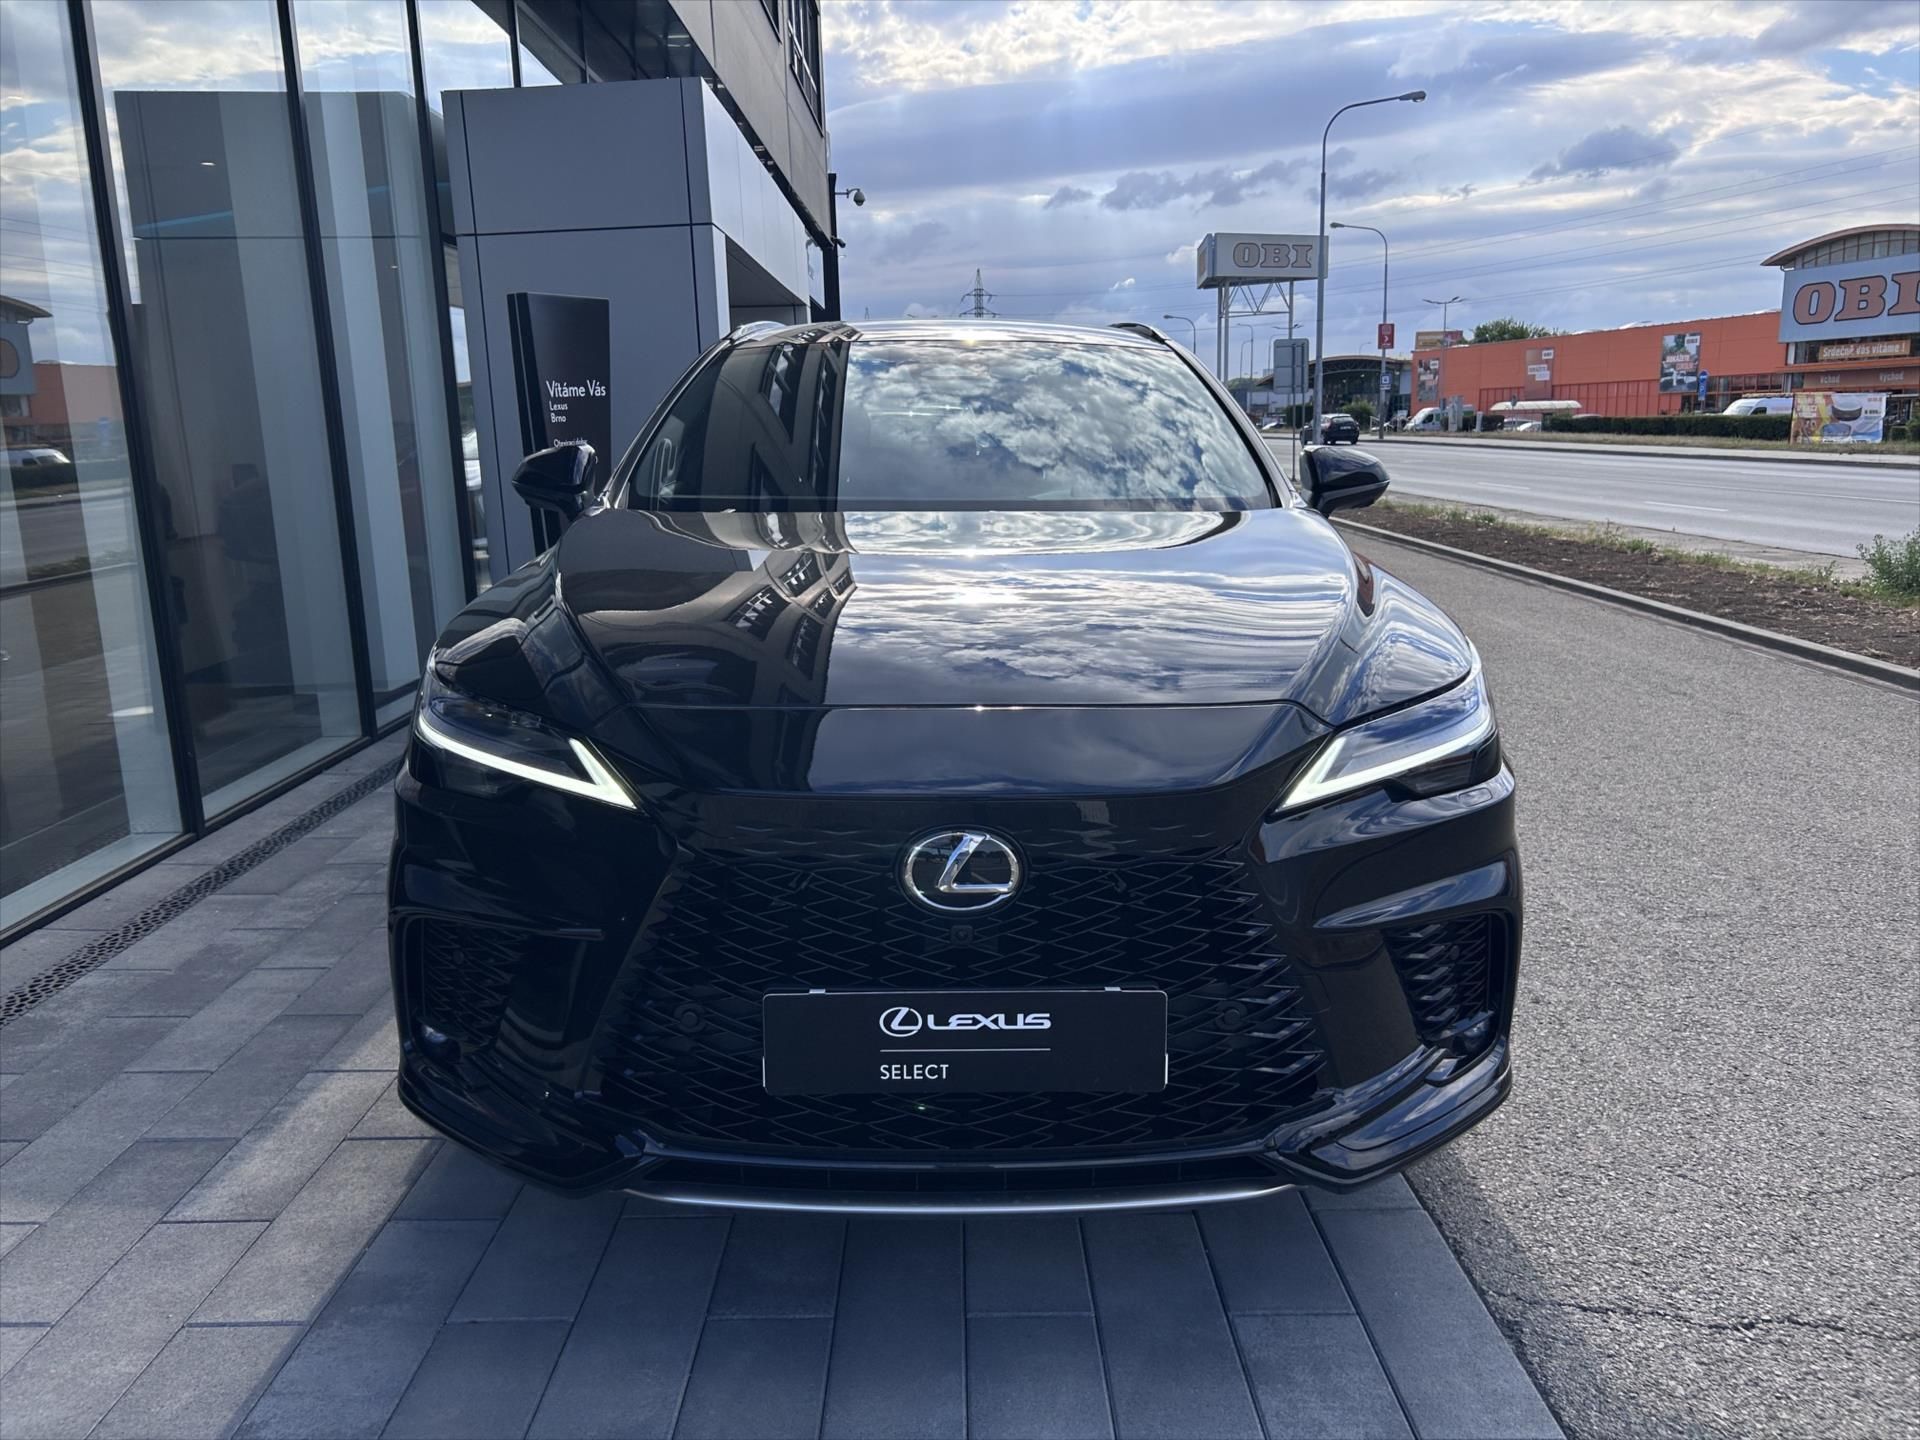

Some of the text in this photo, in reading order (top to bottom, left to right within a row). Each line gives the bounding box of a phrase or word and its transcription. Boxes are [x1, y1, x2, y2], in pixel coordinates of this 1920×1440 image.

[1233, 242, 1313, 269] OBI
[1792, 271, 1920, 326] OBI
[545, 379, 607, 398] Vítáme Vás
[548, 400, 568, 411] Lexus
[550, 412, 567, 423] Brno
[927, 1012, 1052, 1030] LEXUS
[879, 1064, 949, 1080] SELECT
